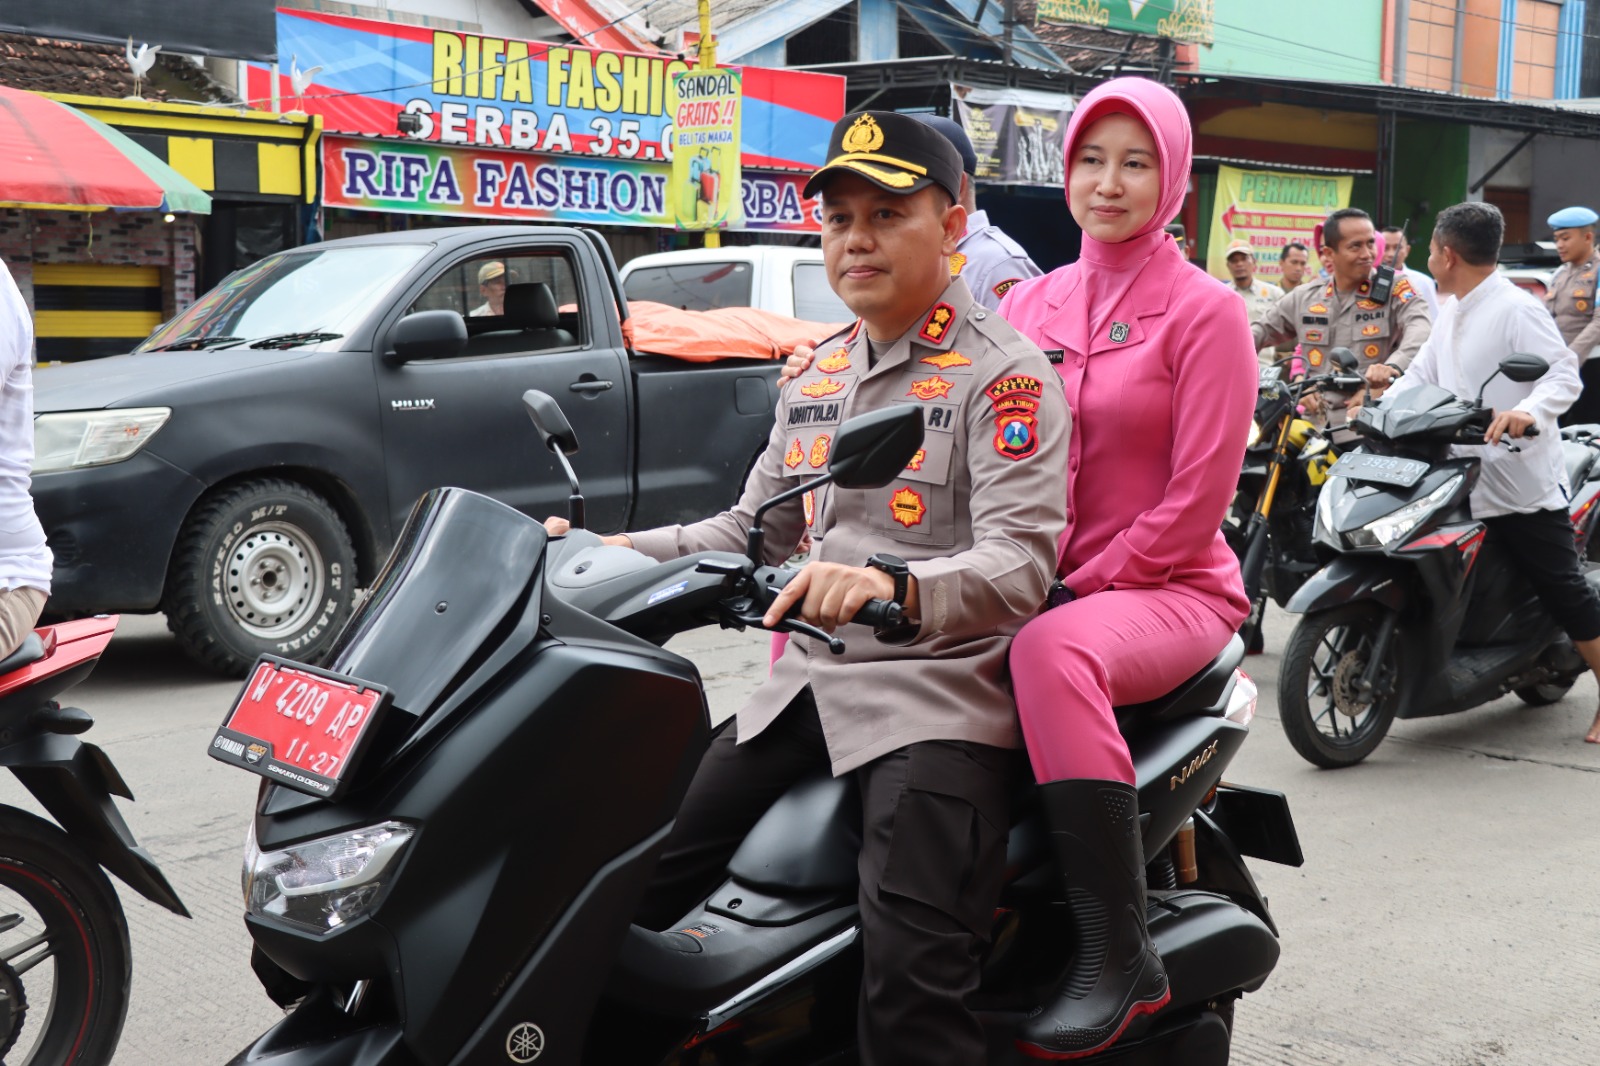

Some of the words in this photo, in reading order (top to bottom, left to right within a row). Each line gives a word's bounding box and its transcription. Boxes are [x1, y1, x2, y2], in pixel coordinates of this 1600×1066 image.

[431, 30, 534, 104] RIFA
[546, 45, 694, 120] FASHIO
[678, 75, 735, 99] SANDAL
[404, 98, 574, 152] SERBA
[677, 100, 720, 129] GRATIS
[679, 133, 693, 146] BELI
[695, 132, 706, 144] TAS
[343, 151, 462, 202] RIFA
[474, 161, 667, 215] FASHION
[741, 182, 803, 221] RBA
[1240, 173, 1338, 207] PERMATA
[1249, 235, 1287, 247] BUBUR
[1355, 311, 1385, 322] POLRI
[996, 377, 1035, 390] POLRES
[391, 399, 436, 411] HILUX
[998, 400, 1014, 408] JAWA
[1016, 400, 1034, 408] TIMUR
[1341, 456, 1354, 464] W
[1361, 457, 1398, 470] 3928
[1403, 462, 1424, 475] DX
[213, 521, 244, 606] SAVERO
[250, 504, 288, 522] M/T
[330, 562, 342, 590] GT
[276, 598, 338, 653] RADIAL
[251, 667, 277, 702] W
[275, 679, 330, 726] 4209
[325, 701, 365, 740] AP
[220, 737, 246, 757] YAMAHA
[267, 764, 298, 781] SEMAKIN
[304, 777, 330, 792] DEPAN
